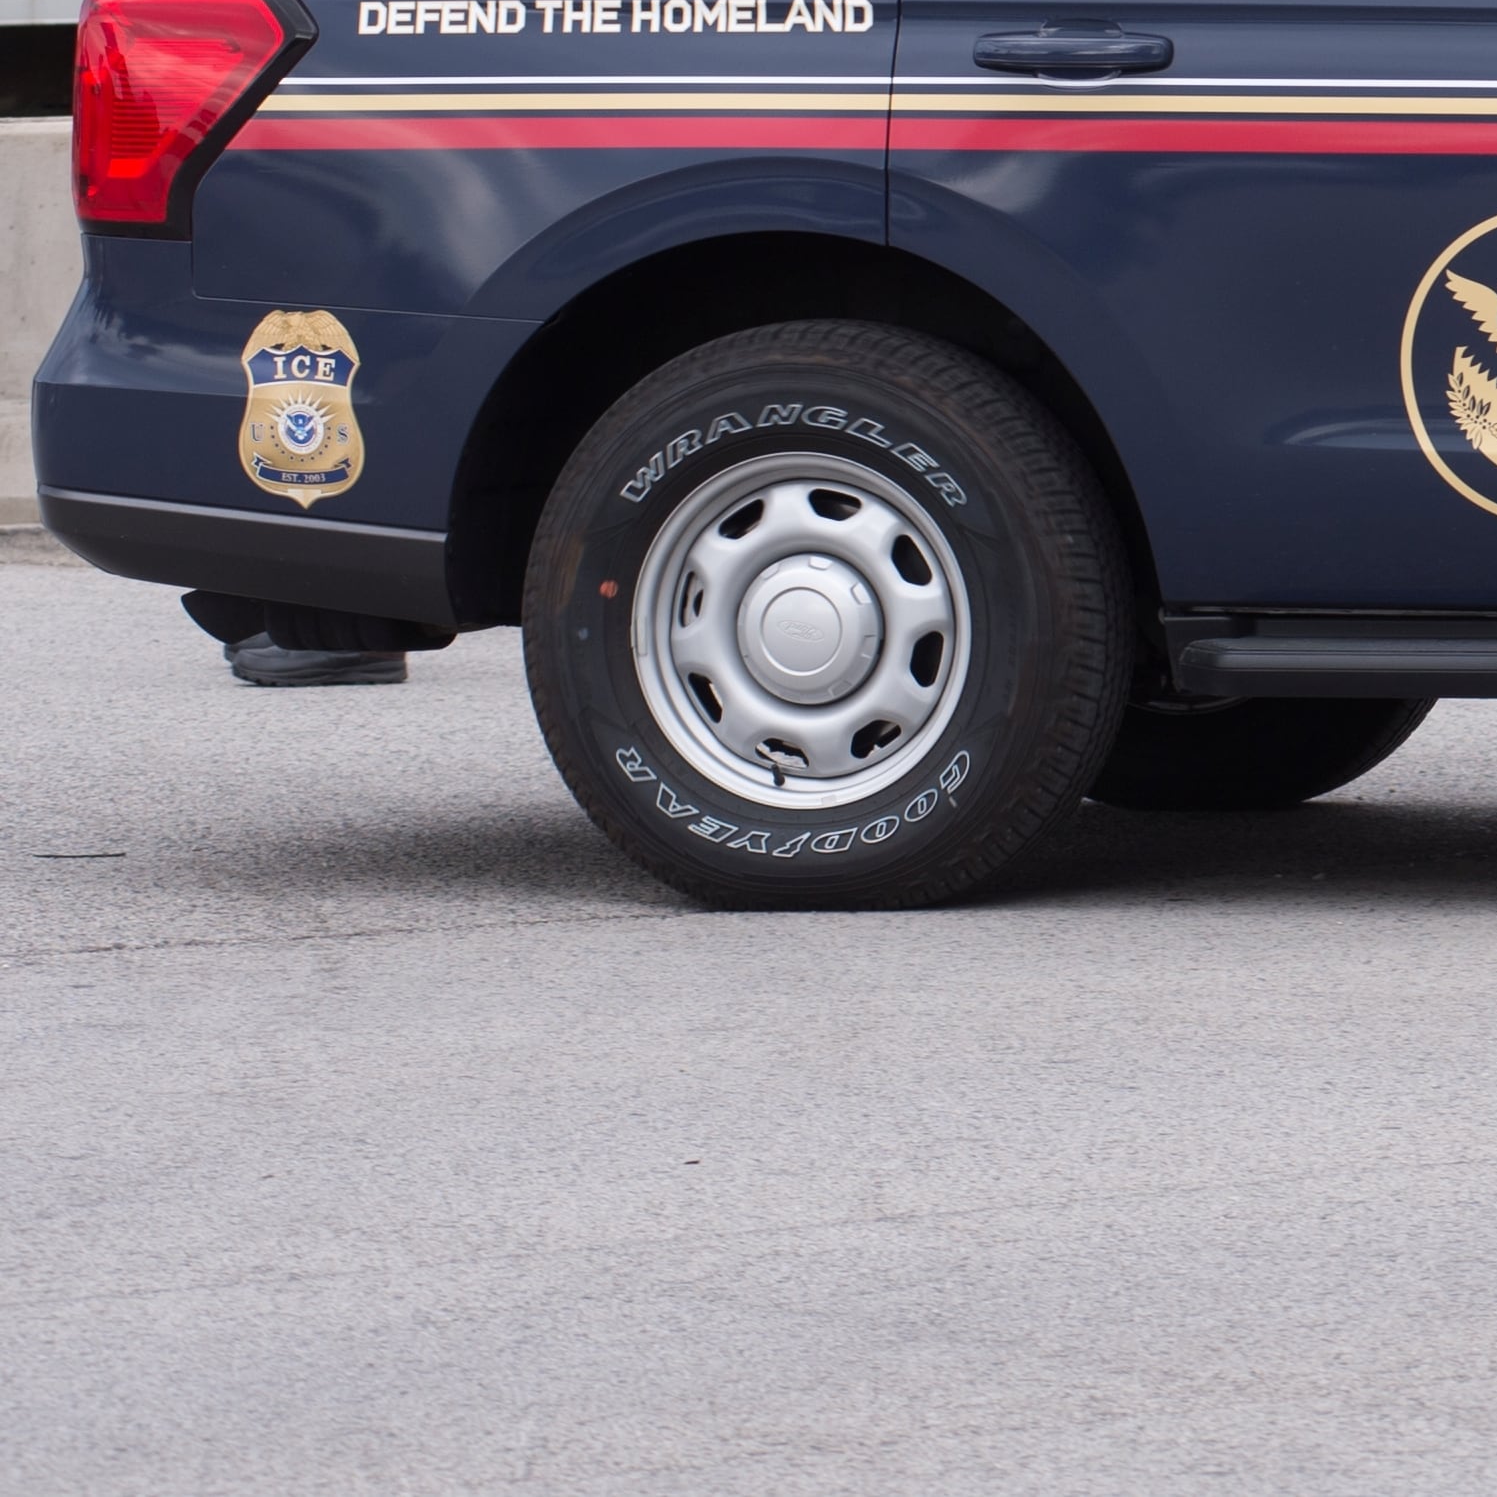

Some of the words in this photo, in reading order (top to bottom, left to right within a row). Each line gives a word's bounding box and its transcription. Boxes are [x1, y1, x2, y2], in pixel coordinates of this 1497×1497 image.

[358, 0, 526, 35] DEFEND
[535, 0, 621, 34] THE
[273, 355, 335, 381] ICE
[249, 423, 265, 443] U
[336, 424, 350, 445] S
[619, 403, 968, 508] WRANGLER
[281, 472, 301, 483] EST.
[304, 473, 326, 483] 2003
[615, 745, 972, 858] GOODYEAR
